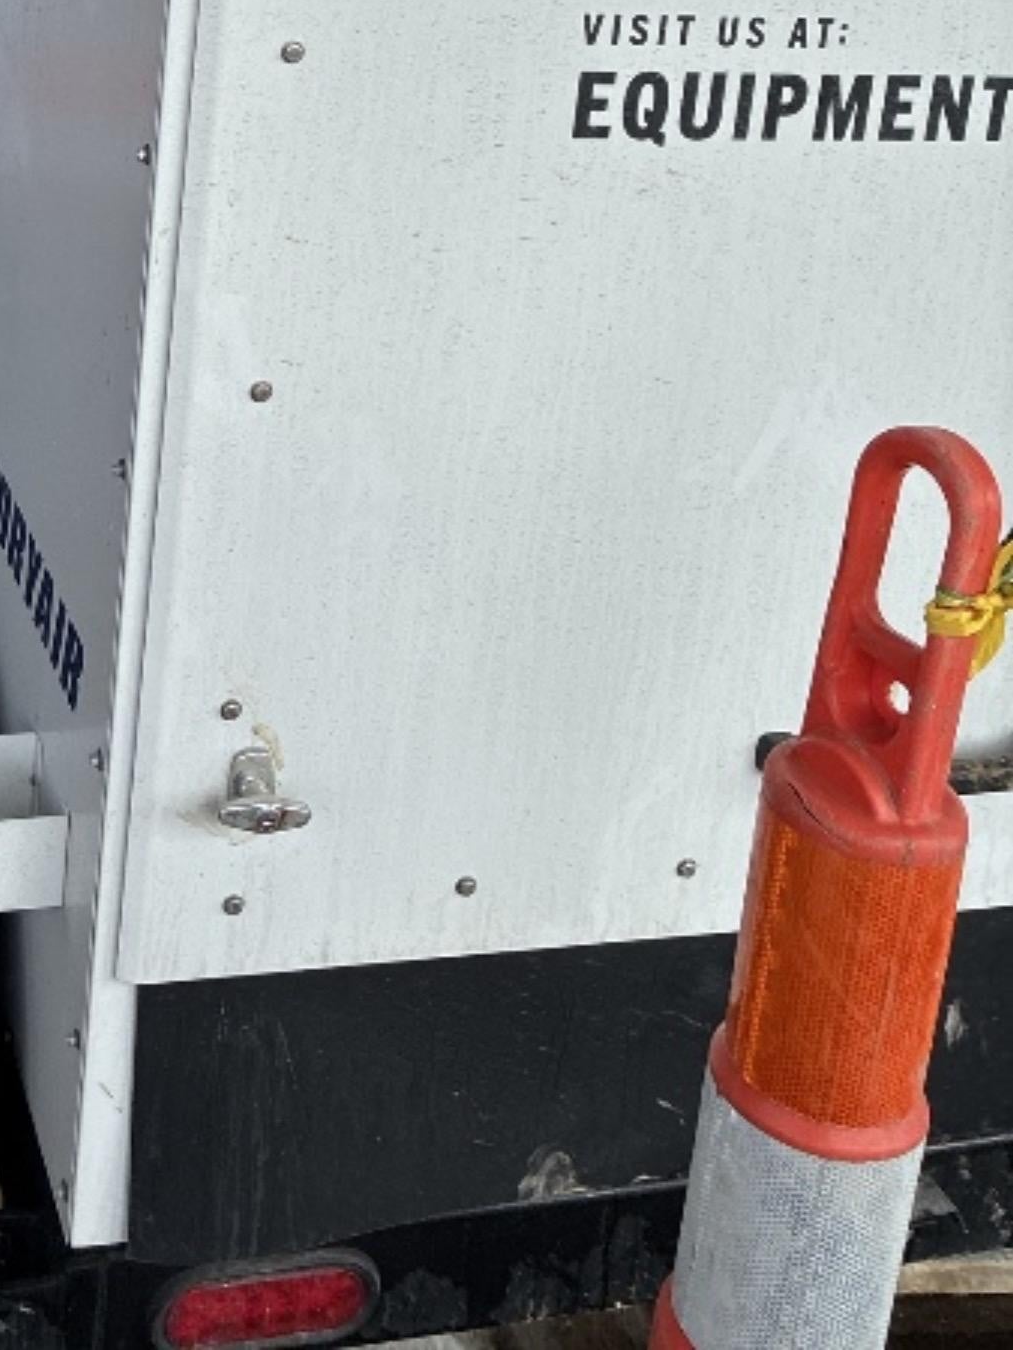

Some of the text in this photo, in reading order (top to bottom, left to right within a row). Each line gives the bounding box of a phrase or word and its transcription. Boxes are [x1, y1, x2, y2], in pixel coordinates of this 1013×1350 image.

[583, 14, 848, 48] VISIT US AT:
[572, 71, 1013, 147] EQUIPMENT
